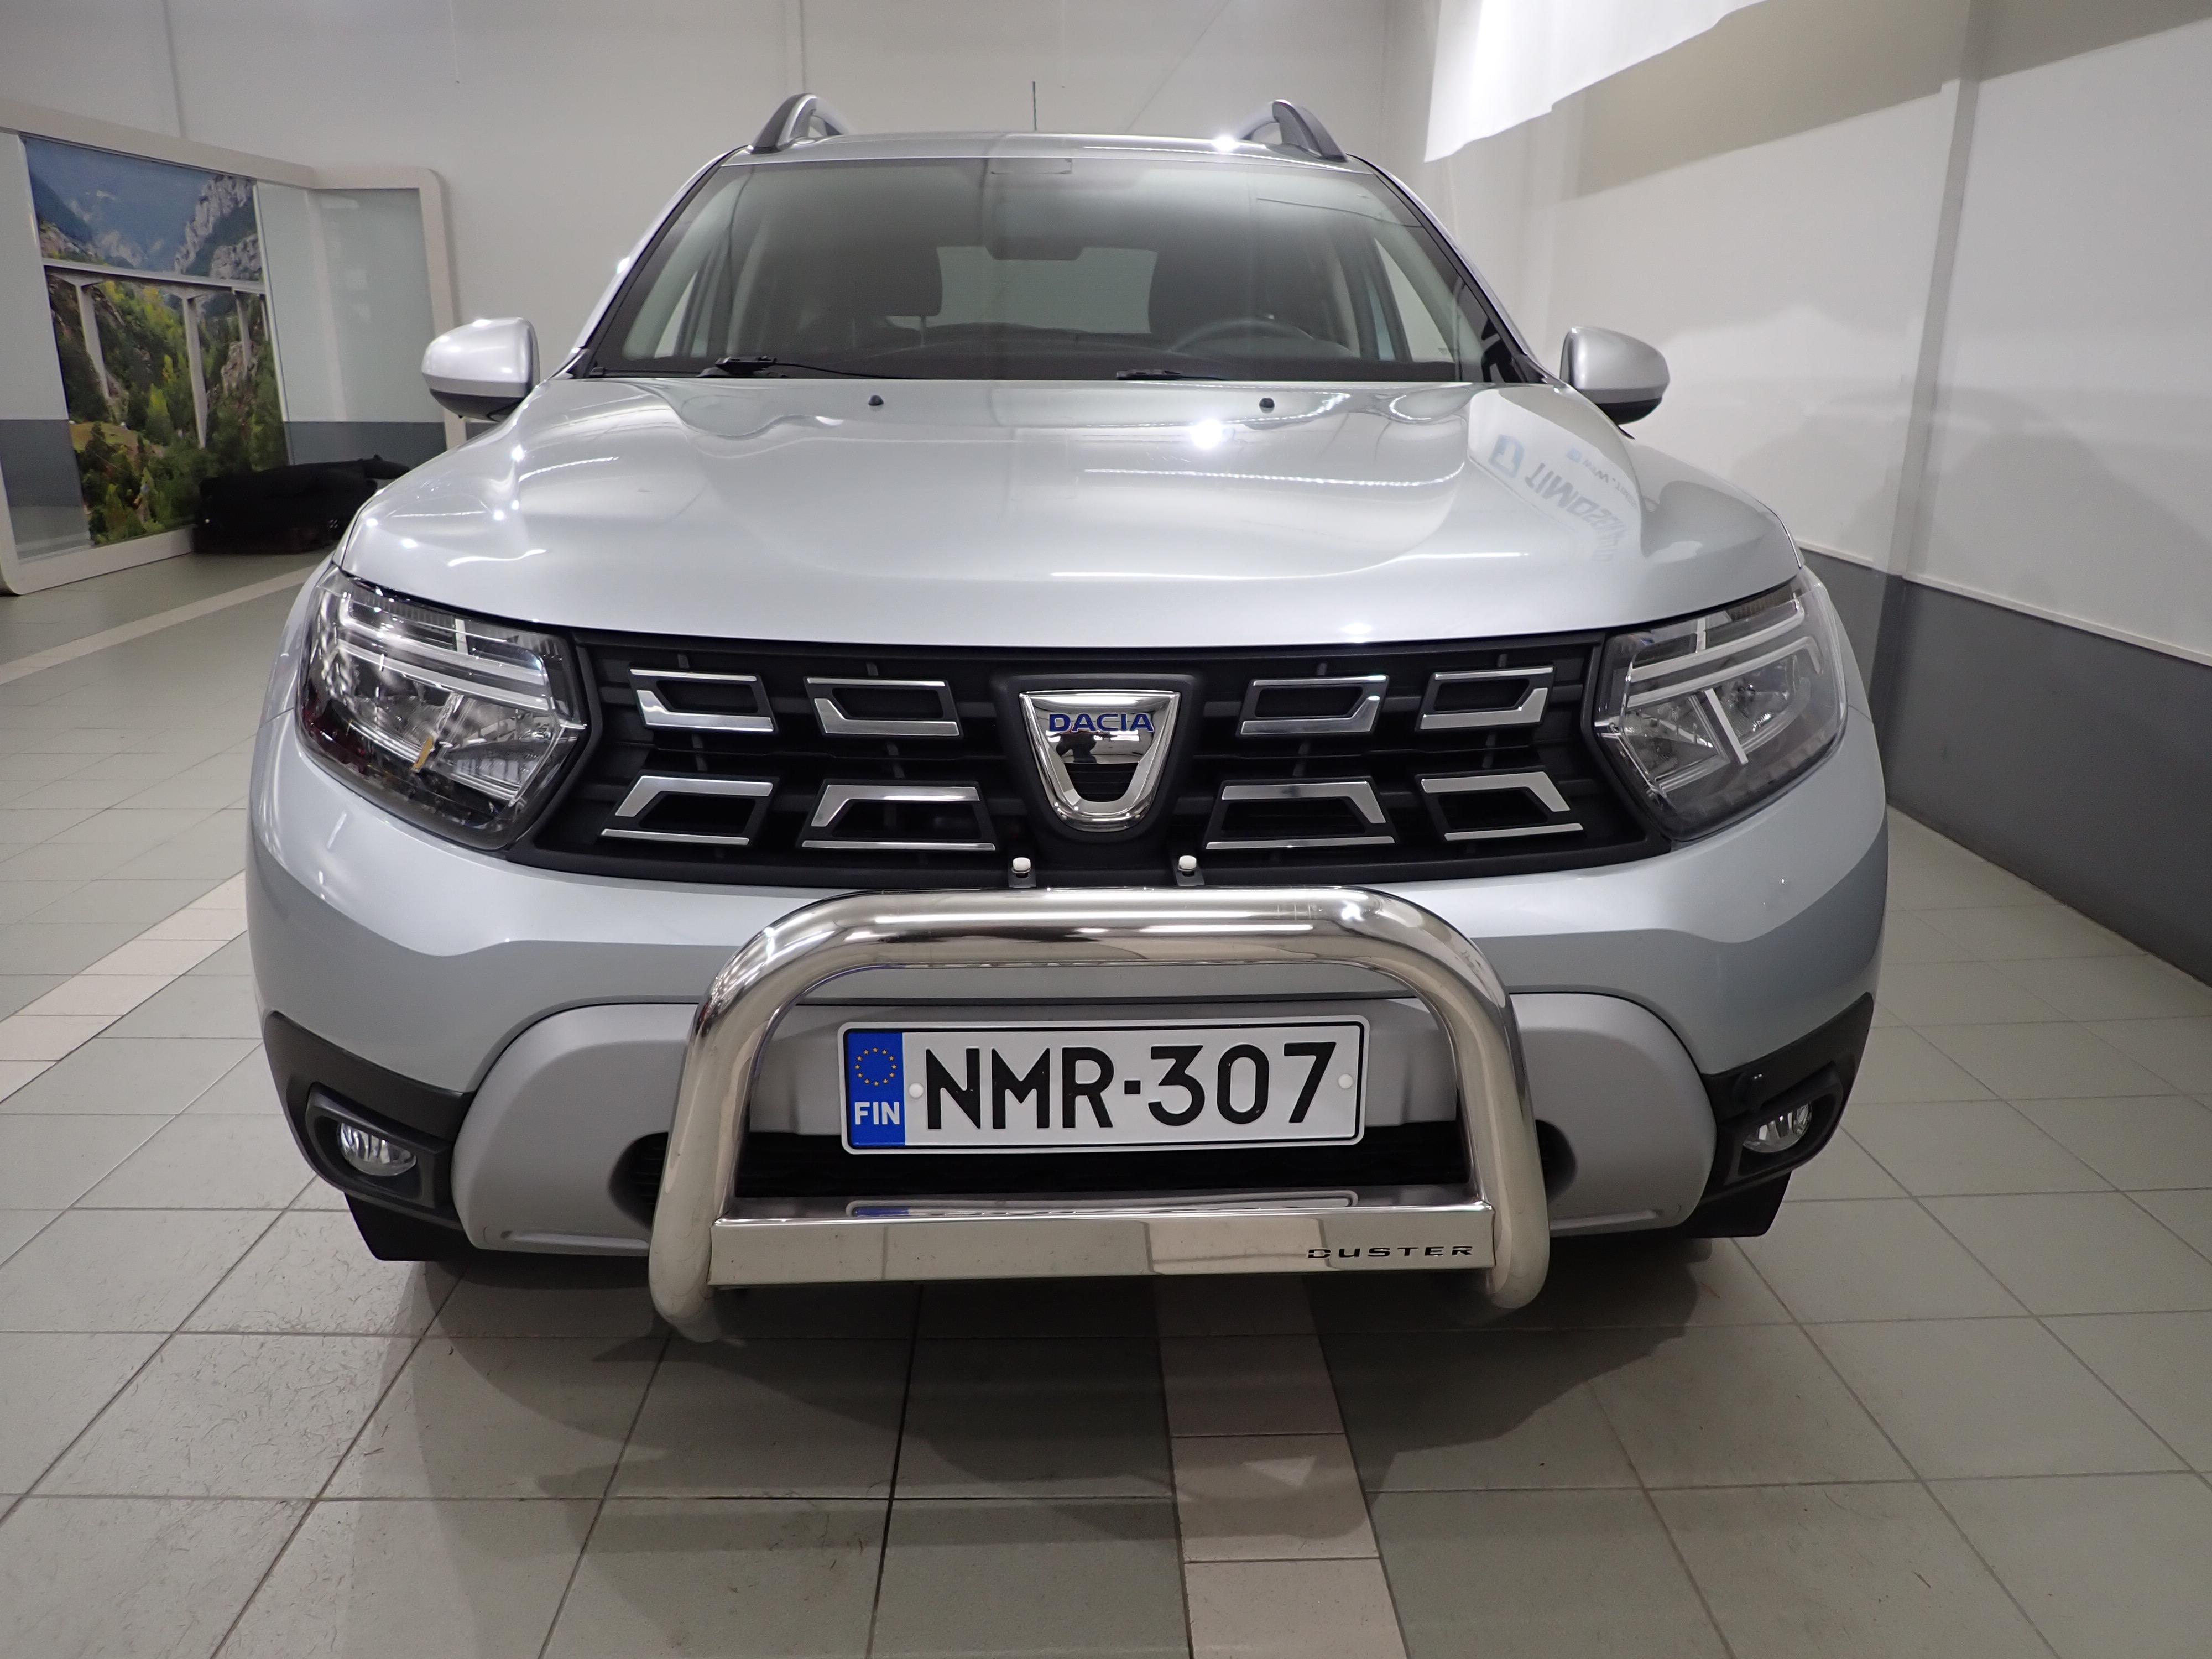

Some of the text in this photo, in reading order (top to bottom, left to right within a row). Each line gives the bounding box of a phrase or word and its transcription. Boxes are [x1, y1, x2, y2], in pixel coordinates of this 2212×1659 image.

[1048, 713, 1155, 733] DACIA
[926, 1041, 1338, 1130] NMR-307
[854, 1102, 900, 1126] FIN
[1308, 1246, 1473, 1259] DUSTER
